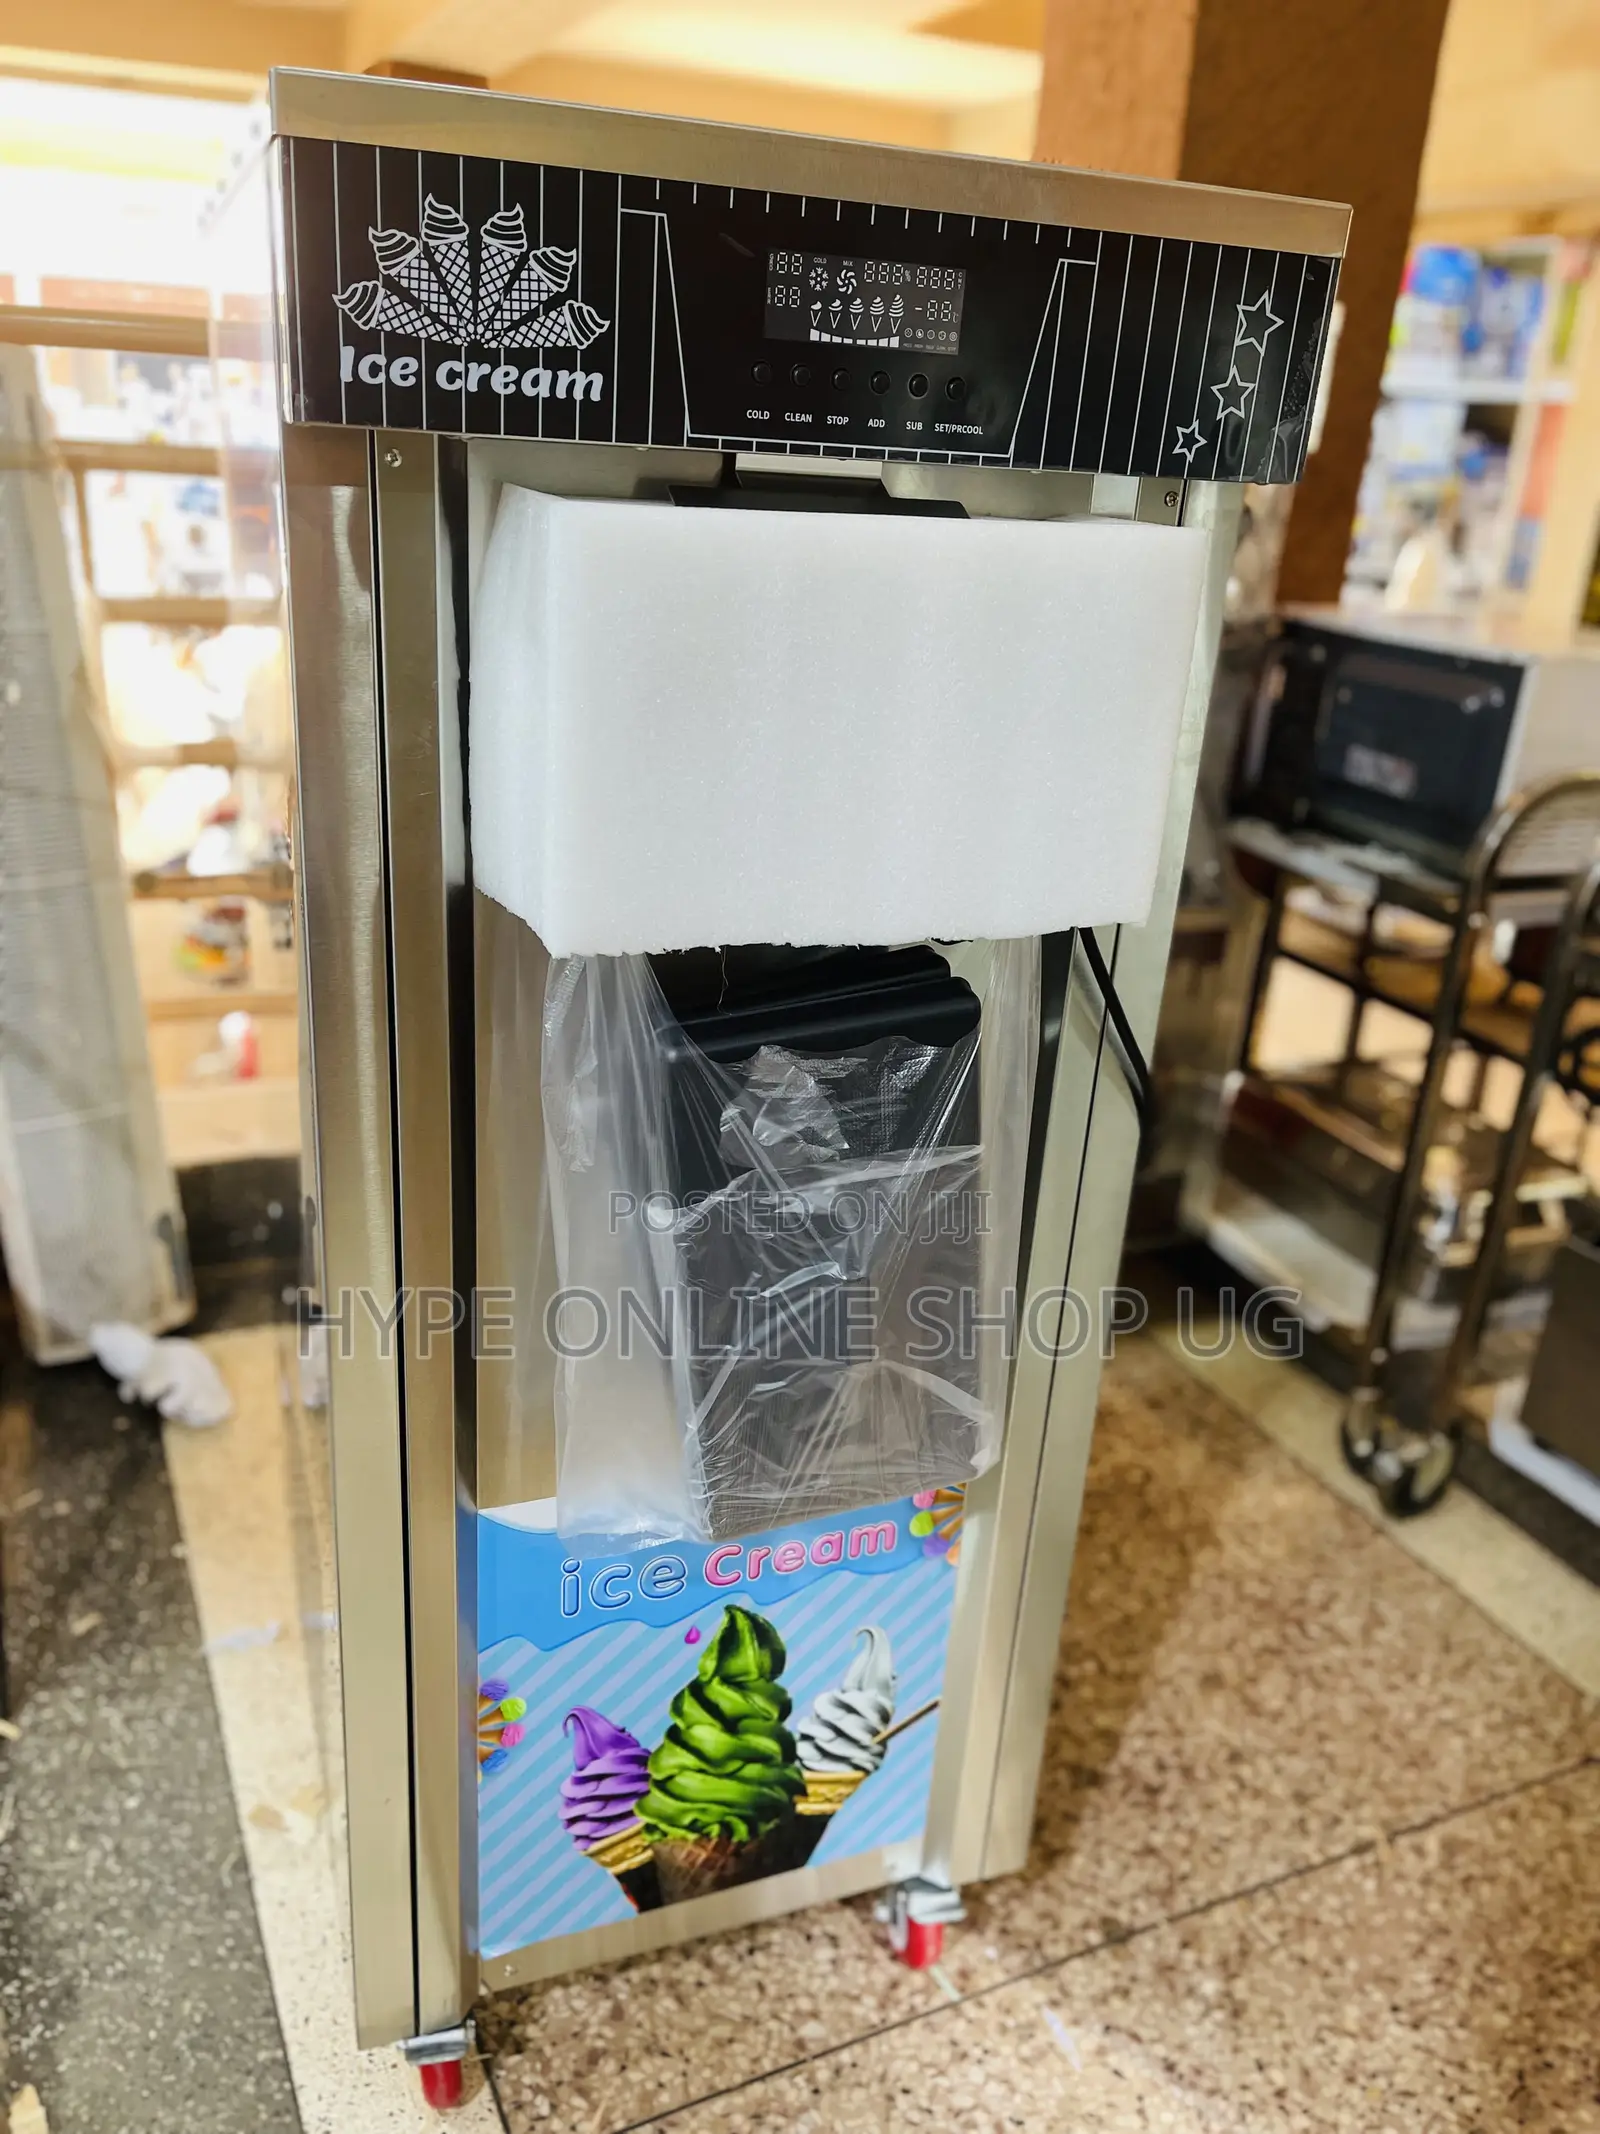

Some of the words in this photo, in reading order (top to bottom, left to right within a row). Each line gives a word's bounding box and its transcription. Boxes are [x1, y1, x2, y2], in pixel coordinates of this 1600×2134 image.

[340, 345, 420, 387] Ice
[435, 359, 605, 402] cream
[746, 409, 770, 420] COLD
[784, 412, 813, 423] CLEAN
[826, 415, 849, 425] STOP
[867, 418, 886, 428] ADD
[905, 421, 923, 431] SUB
[934, 423, 984, 435] SET/PRCOOL
[560, 1554, 687, 1617] ice
[703, 1520, 898, 1587] Cream
